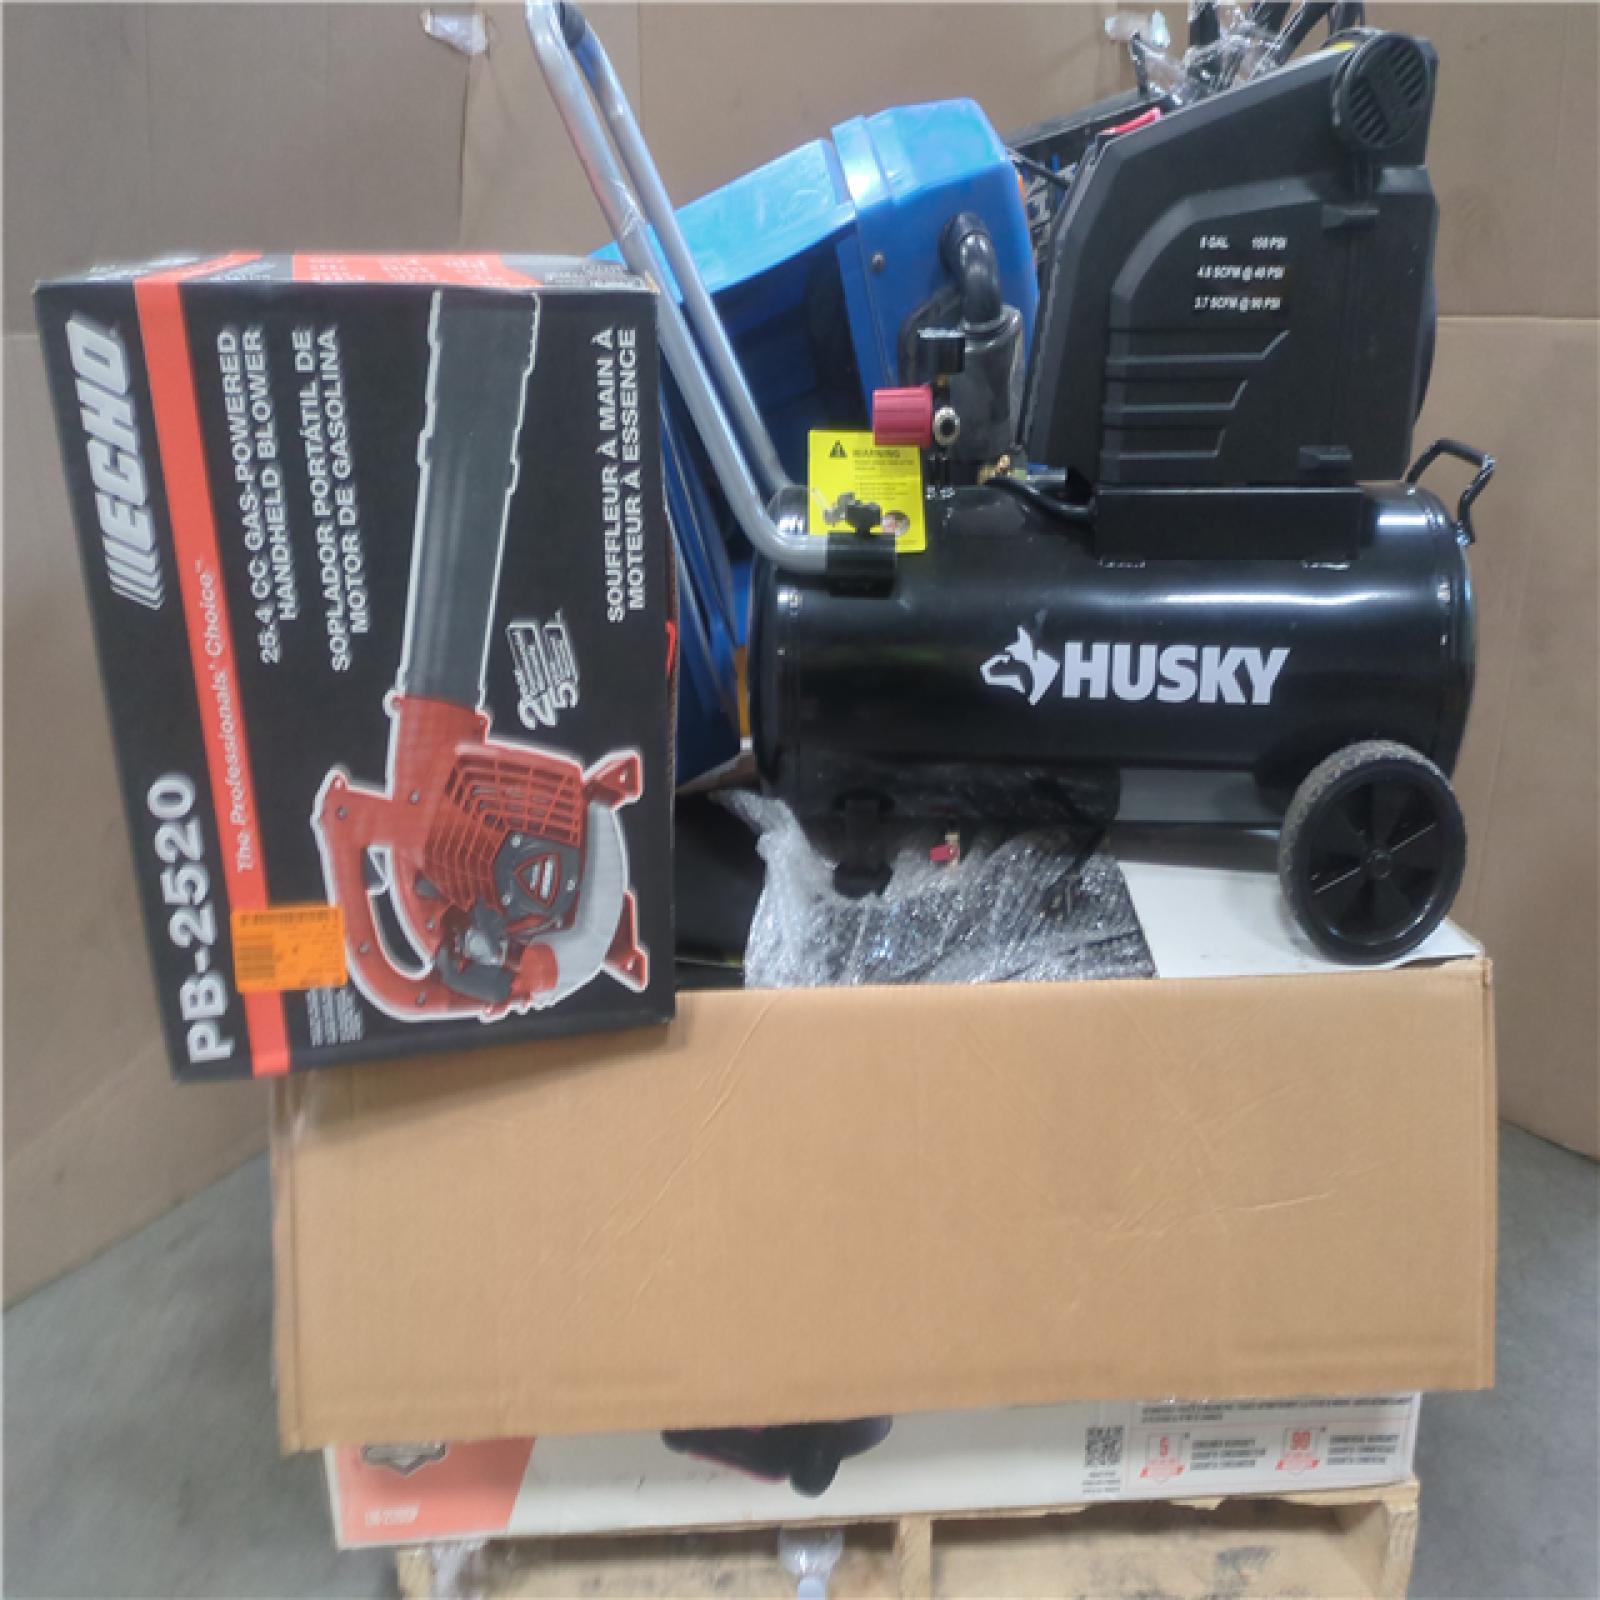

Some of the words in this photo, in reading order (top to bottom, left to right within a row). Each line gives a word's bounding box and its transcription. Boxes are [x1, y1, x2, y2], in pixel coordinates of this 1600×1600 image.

[1267, 265, 1285, 279] PSI
[1270, 236, 1287, 250] PSI
[591, 327, 613, 348] À
[1264, 296, 1282, 310] PSI
[292, 328, 316, 373] DE
[242, 328, 276, 459] BLOWER
[317, 328, 352, 480] GASOLINA
[597, 359, 616, 431] MAIN
[618, 327, 641, 462] ESSENCE
[65, 317, 153, 553] ECHO
[217, 329, 265, 551] GAS-POWERED
[300, 380, 333, 517] PORTÁTIL
[596, 438, 618, 459] À
[334, 487, 356, 526] DE
[620, 468, 642, 488] À
[249, 556, 271, 600] CC
[261, 467, 298, 620] HANDHELD
[602, 465, 624, 623] SOUFFLEUR
[624, 491, 646, 610] MOTEUR
[316, 523, 351, 672] SOPLADOR
[340, 534, 369, 633] MOTOR
[255, 608, 281, 664] 25.4
[1062, 641, 1291, 705] HUSKY
[235, 829, 254, 872] The
[147, 772, 235, 1065] PB-2520
